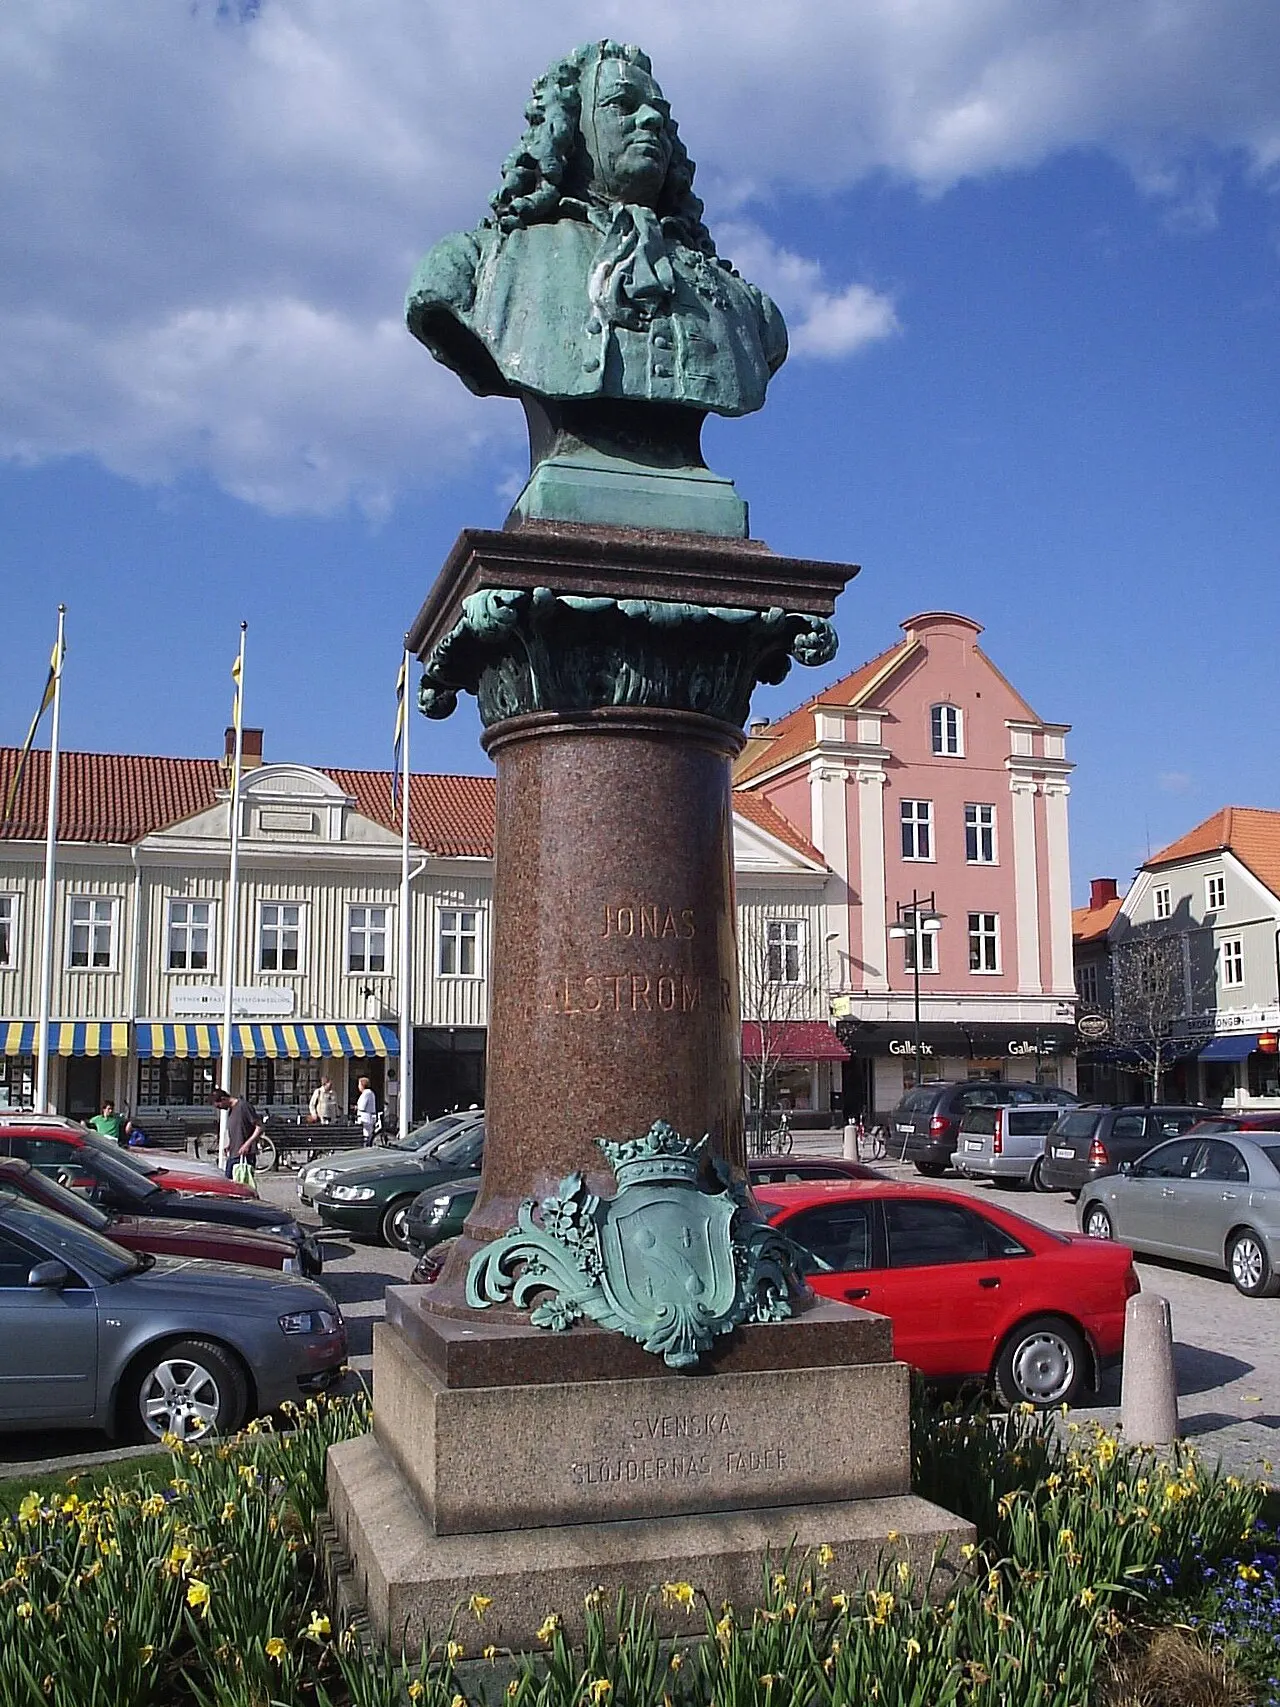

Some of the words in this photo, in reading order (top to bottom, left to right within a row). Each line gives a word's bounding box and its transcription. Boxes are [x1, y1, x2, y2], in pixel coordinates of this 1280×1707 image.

[600, 904, 696, 939] JONAS
[541, 964, 731, 1014] ALSTRÖMR
[888, 1040, 934, 1055] Galleix
[1008, 1040, 1050, 1055] Galler
[632, 1413, 732, 1440] SVENSKA
[571, 1455, 712, 1485] SLÖJDERNAS
